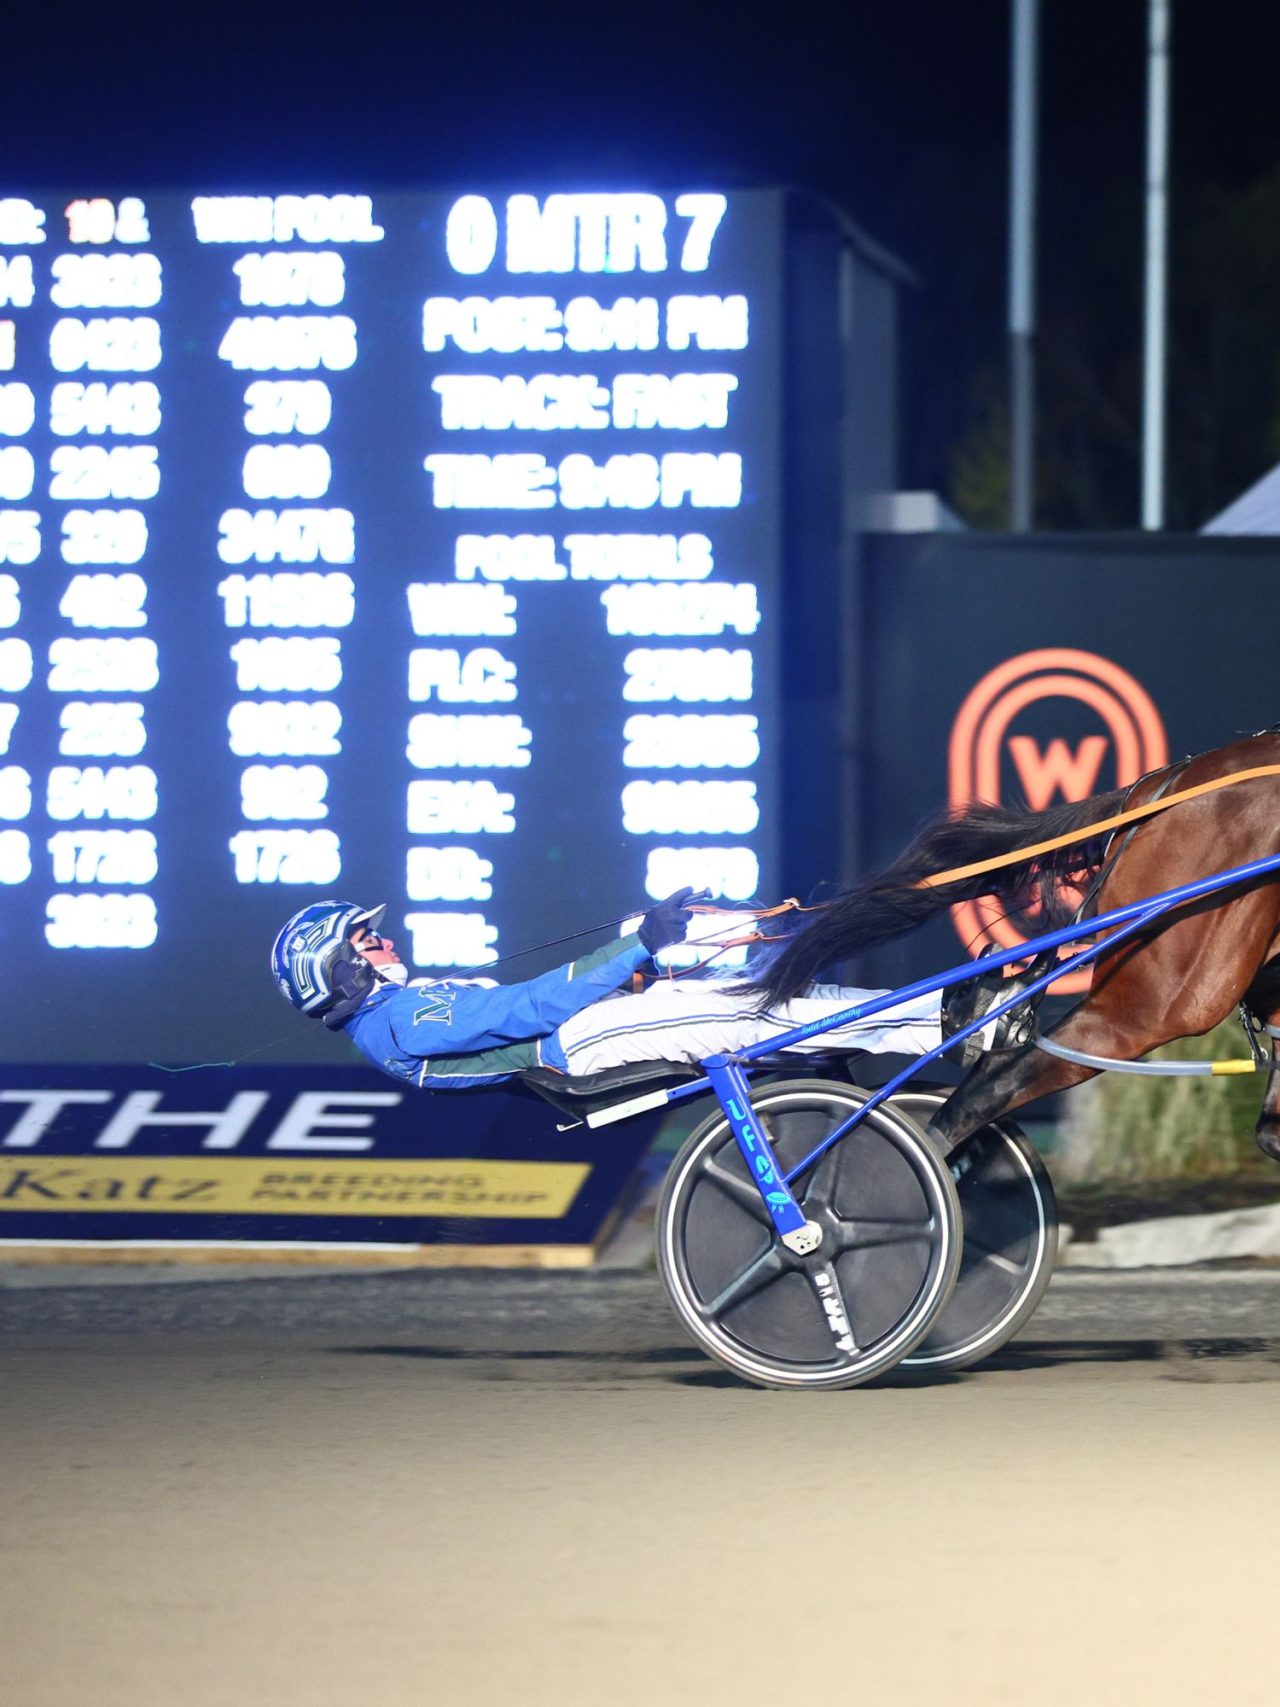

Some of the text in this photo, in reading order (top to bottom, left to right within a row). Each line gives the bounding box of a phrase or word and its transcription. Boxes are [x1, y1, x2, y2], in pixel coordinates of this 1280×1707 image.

[675, 194, 727, 272] 7
[667, 295, 748, 350] PM
[613, 373, 739, 429] FAST
[660, 453, 742, 507] PM
[0, 1090, 402, 1151] THE
[1, 1168, 221, 1201] Katz
[251, 1188, 549, 1204] PARTNERSHIP
[260, 1171, 485, 1188] BREEDING
